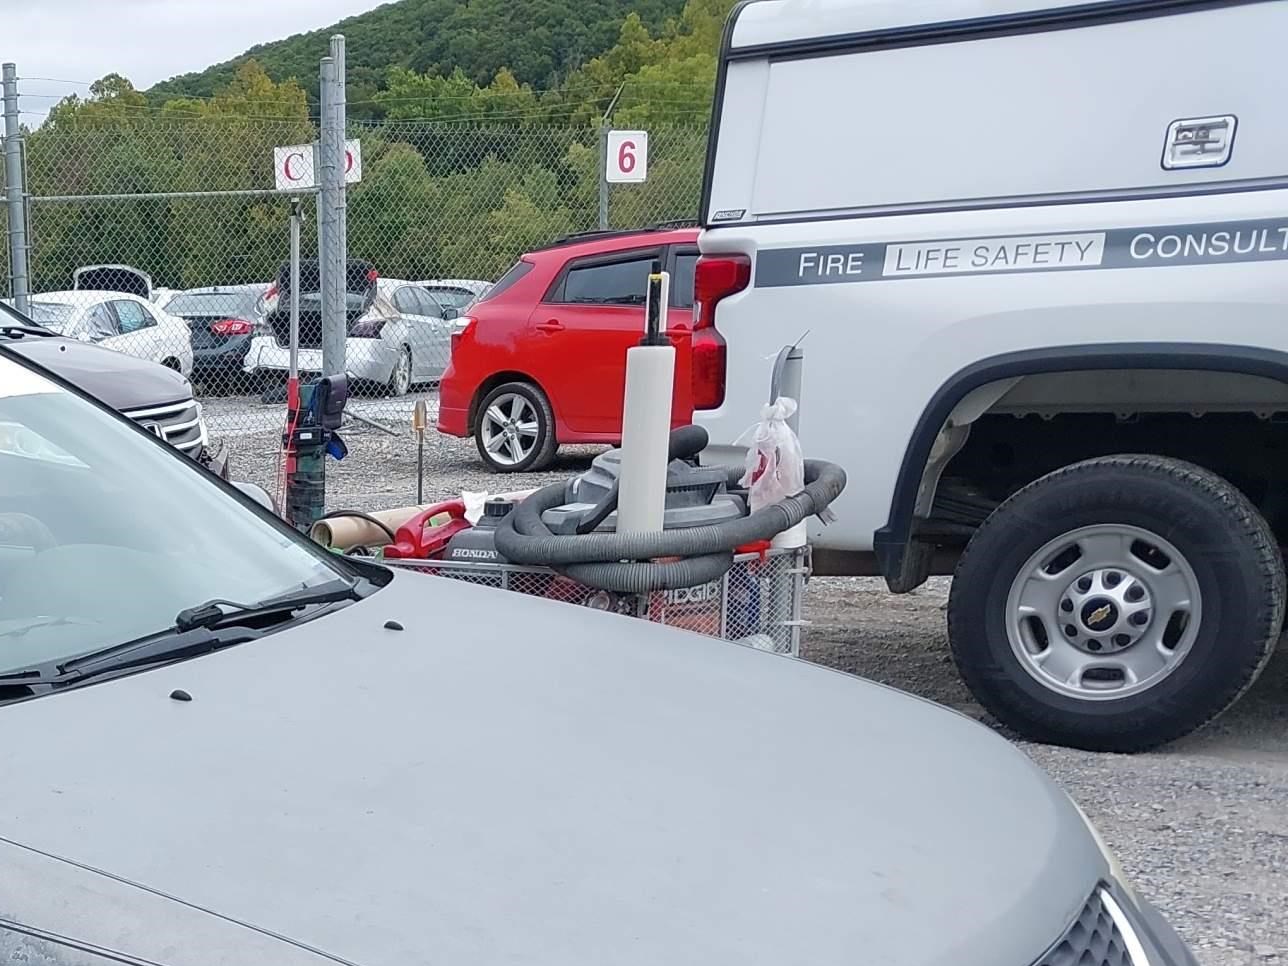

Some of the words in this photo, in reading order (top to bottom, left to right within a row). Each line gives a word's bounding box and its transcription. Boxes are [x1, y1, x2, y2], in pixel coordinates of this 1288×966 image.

[284, 153, 306, 181] C
[618, 142, 636, 173] 6
[798, 252, 865, 277] FIRE
[895, 247, 961, 272] LIFE
[970, 240, 1097, 267] SAFETY
[452, 548, 499, 559] HONDA
